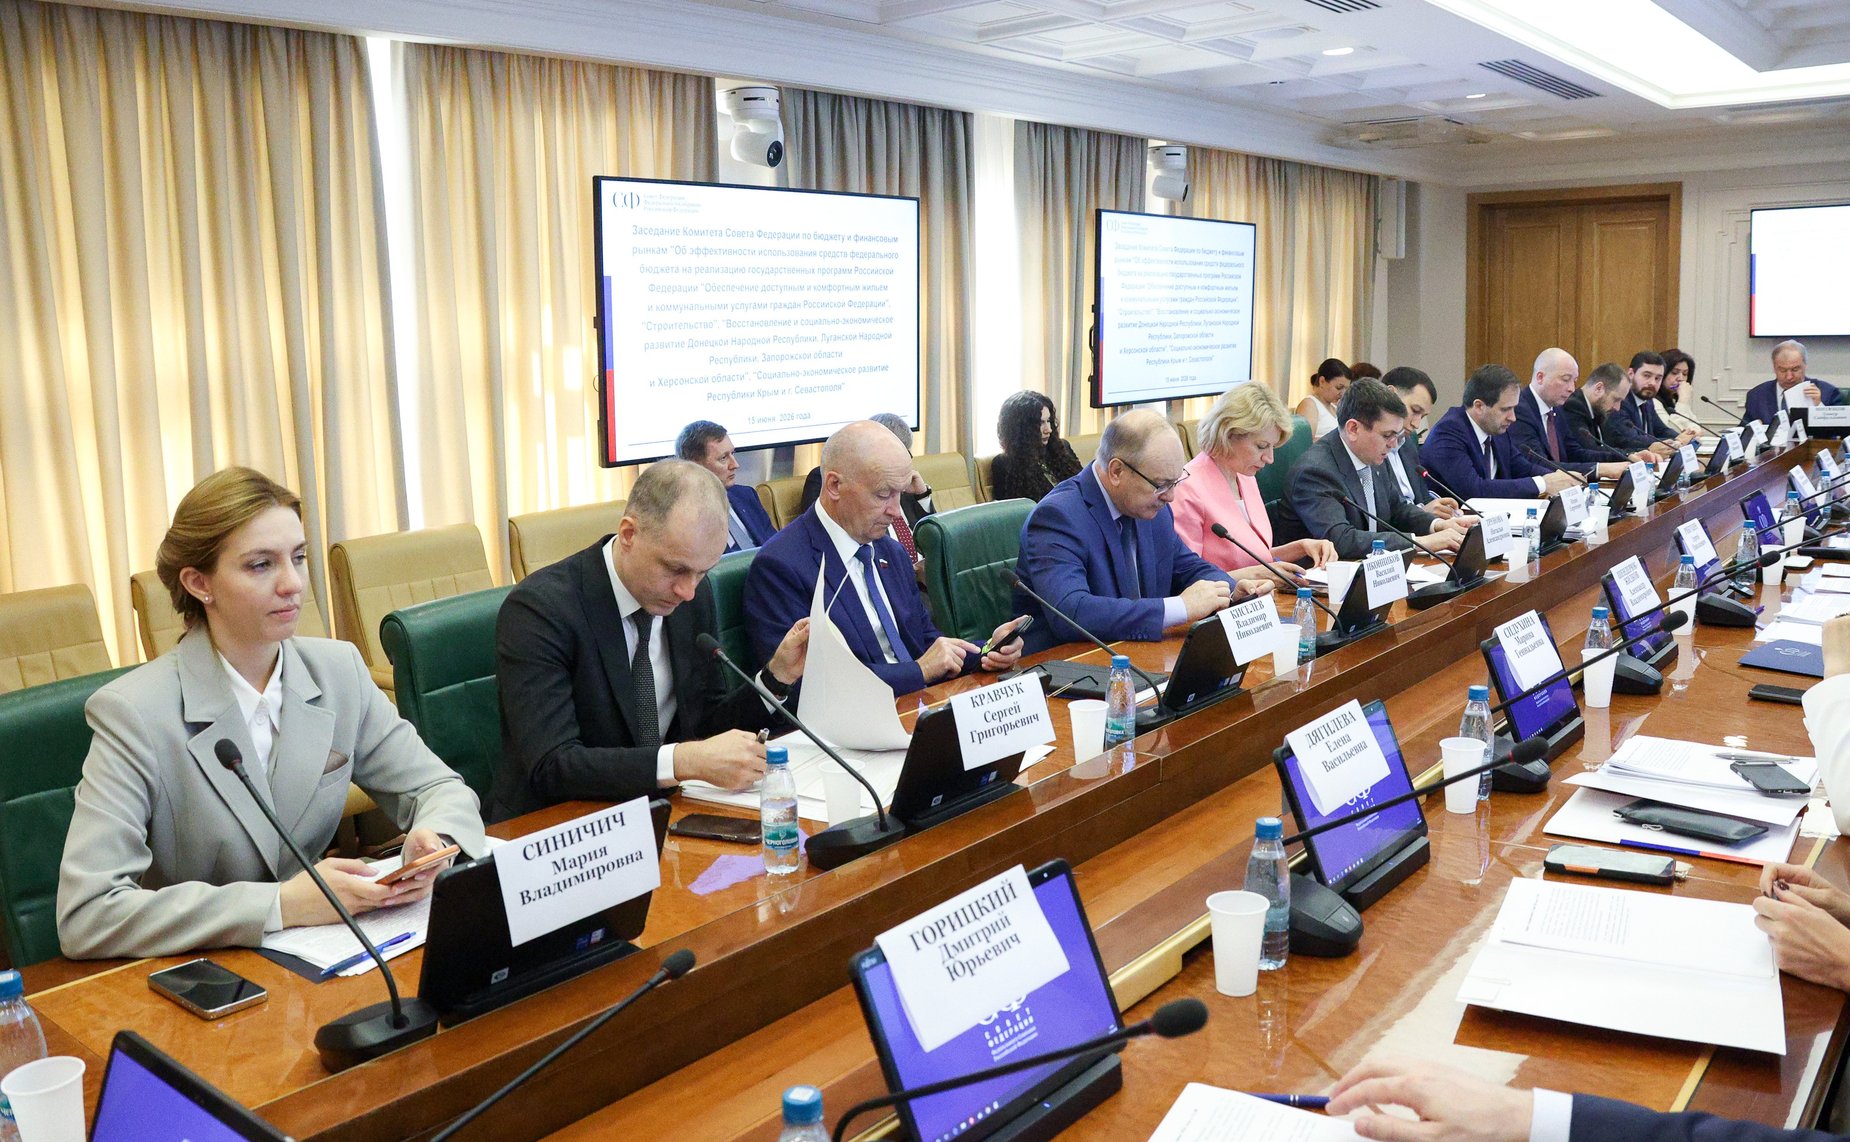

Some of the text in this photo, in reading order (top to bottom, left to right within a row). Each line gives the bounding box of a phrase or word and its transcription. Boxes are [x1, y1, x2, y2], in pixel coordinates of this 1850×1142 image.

[632, 224, 681, 236] Заседание
[682, 226, 723, 237] Комитета
[725, 227, 754, 238] Совета
[756, 229, 800, 240] Федерации
[812, 231, 846, 243] бюджету
[852, 233, 899, 243] финансовым
[632, 246, 668, 256] рынкам
[689, 246, 756, 256] эффективности
[758, 248, 817, 256] использования
[818, 250, 848, 259] средств
[849, 249, 899, 260] федерального
[639, 263, 679, 273] бюджета
[694, 266, 746, 275] реализацию
[747, 266, 815, 276] государственных
[817, 267, 853, 276] программ
[853, 265, 894, 275] Российской
[647, 283, 698, 294] Федерации
[760, 284, 805, 294] доступным
[813, 283, 860, 293] комфортным
[655, 303, 729, 313] коммунальными
[730, 302, 768, 312] услугами
[769, 301, 802, 311] граждан
[803, 299, 846, 308] Российской
[799, 316, 894, 326] социально-экономическое
[644, 340, 685, 351] развитие
[687, 337, 729, 349] Донецкой
[730, 336, 771, 347] Народной
[820, 332, 857, 343] Луганской
[858, 332, 892, 342] Народной
[761, 352, 812, 362] Запорожской
[813, 349, 843, 359] области
[657, 376, 709, 388] Херсонской
[857, 364, 889, 374] развитие
[706, 389, 755, 402] Республики
[756, 388, 779, 398] Крым
[1366, 554, 1400, 571] ИКОННИКОВ
[1230, 600, 1265, 620] КИСЕЛЕВ
[1235, 613, 1267, 629] Владимир
[1236, 621, 1273, 640] Николаевич
[1514, 631, 1535, 646] Марина
[970, 682, 1024, 708] КРАВЧУК
[983, 701, 1021, 723] Сергей
[969, 713, 1040, 744] Григорьевич
[1305, 710, 1357, 749] ДЯГИЛЕВА
[1325, 733, 1352, 753] Елена
[1321, 740, 1369, 773] Васильевна
[522, 811, 626, 861] СИНИЧИЧ
[551, 846, 608, 875] Мария
[519, 850, 644, 906] Владимировна
[909, 878, 1019, 952] ГОРИЦКИЙ
[938, 911, 1012, 968] Дмитрий
[946, 932, 1022, 982] Юрьевич
